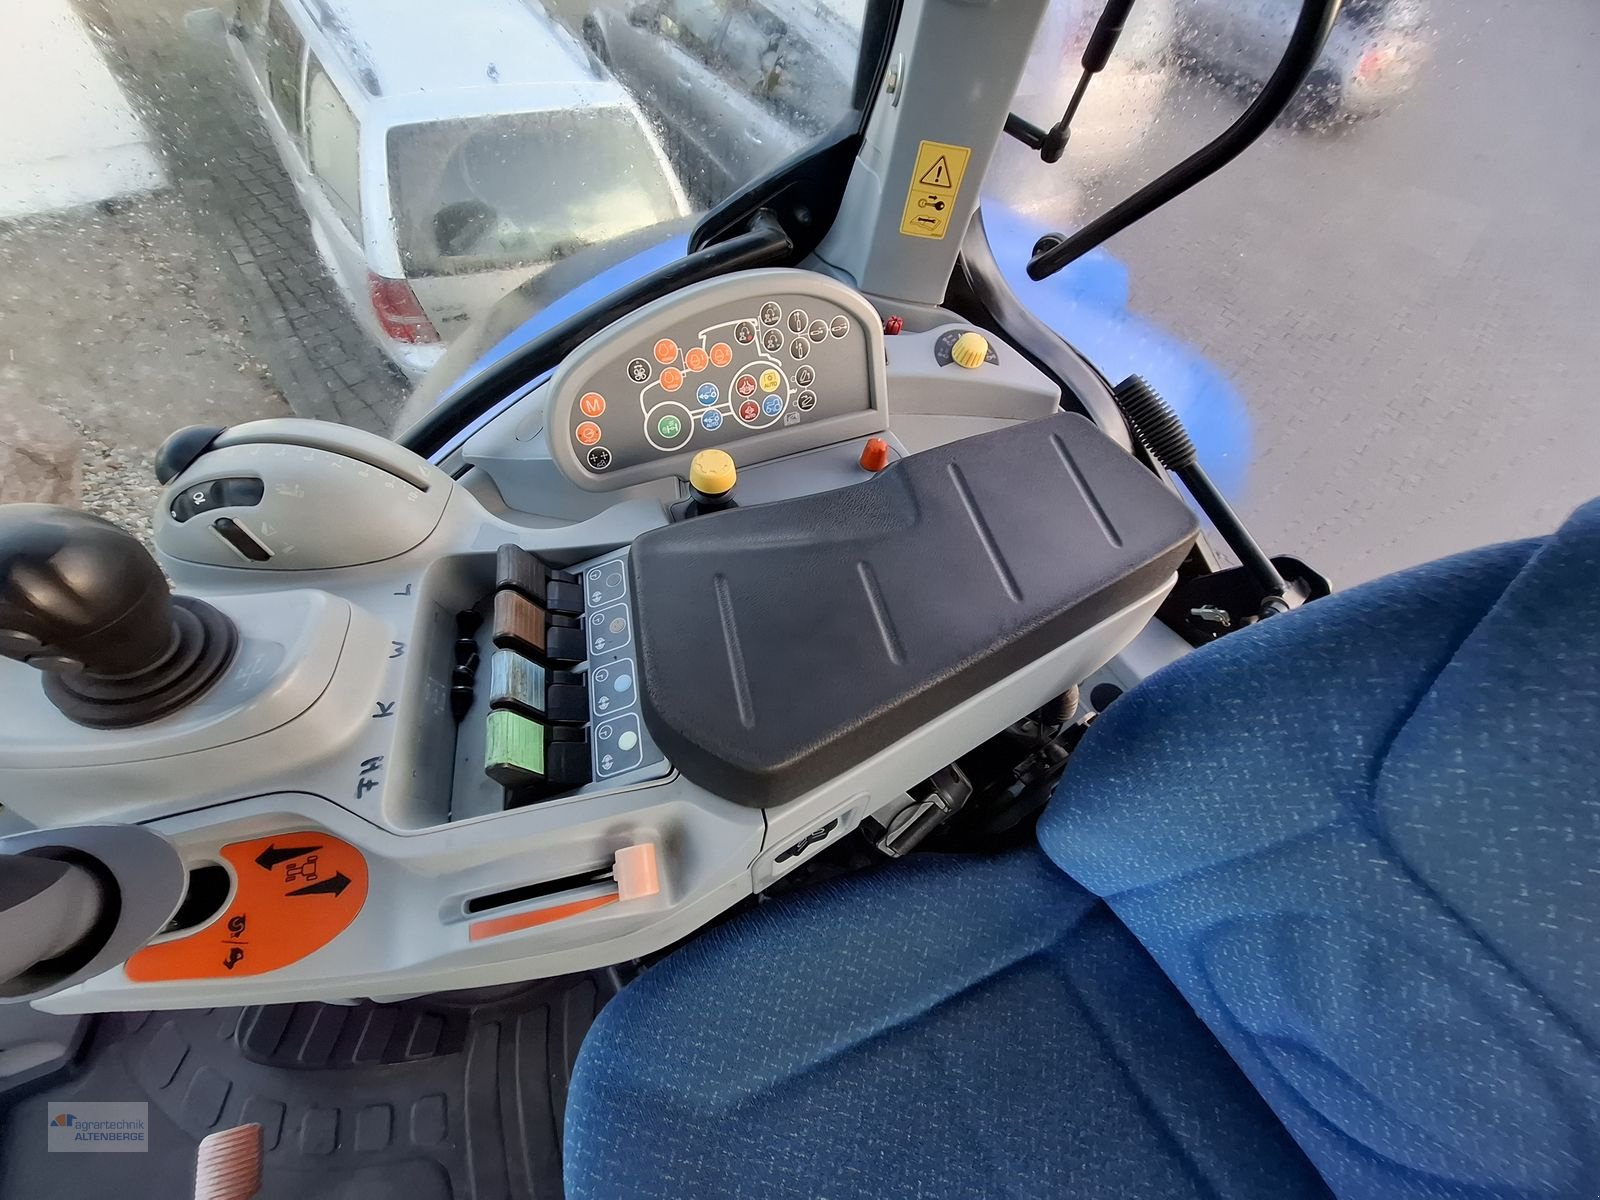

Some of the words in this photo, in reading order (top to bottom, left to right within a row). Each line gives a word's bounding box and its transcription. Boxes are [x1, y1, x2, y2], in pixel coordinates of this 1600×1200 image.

[764, 381, 778, 389] AUTO
[585, 398, 600, 413] M
[706, 420, 719, 428] AUTO
[372, 701, 395, 719] K
